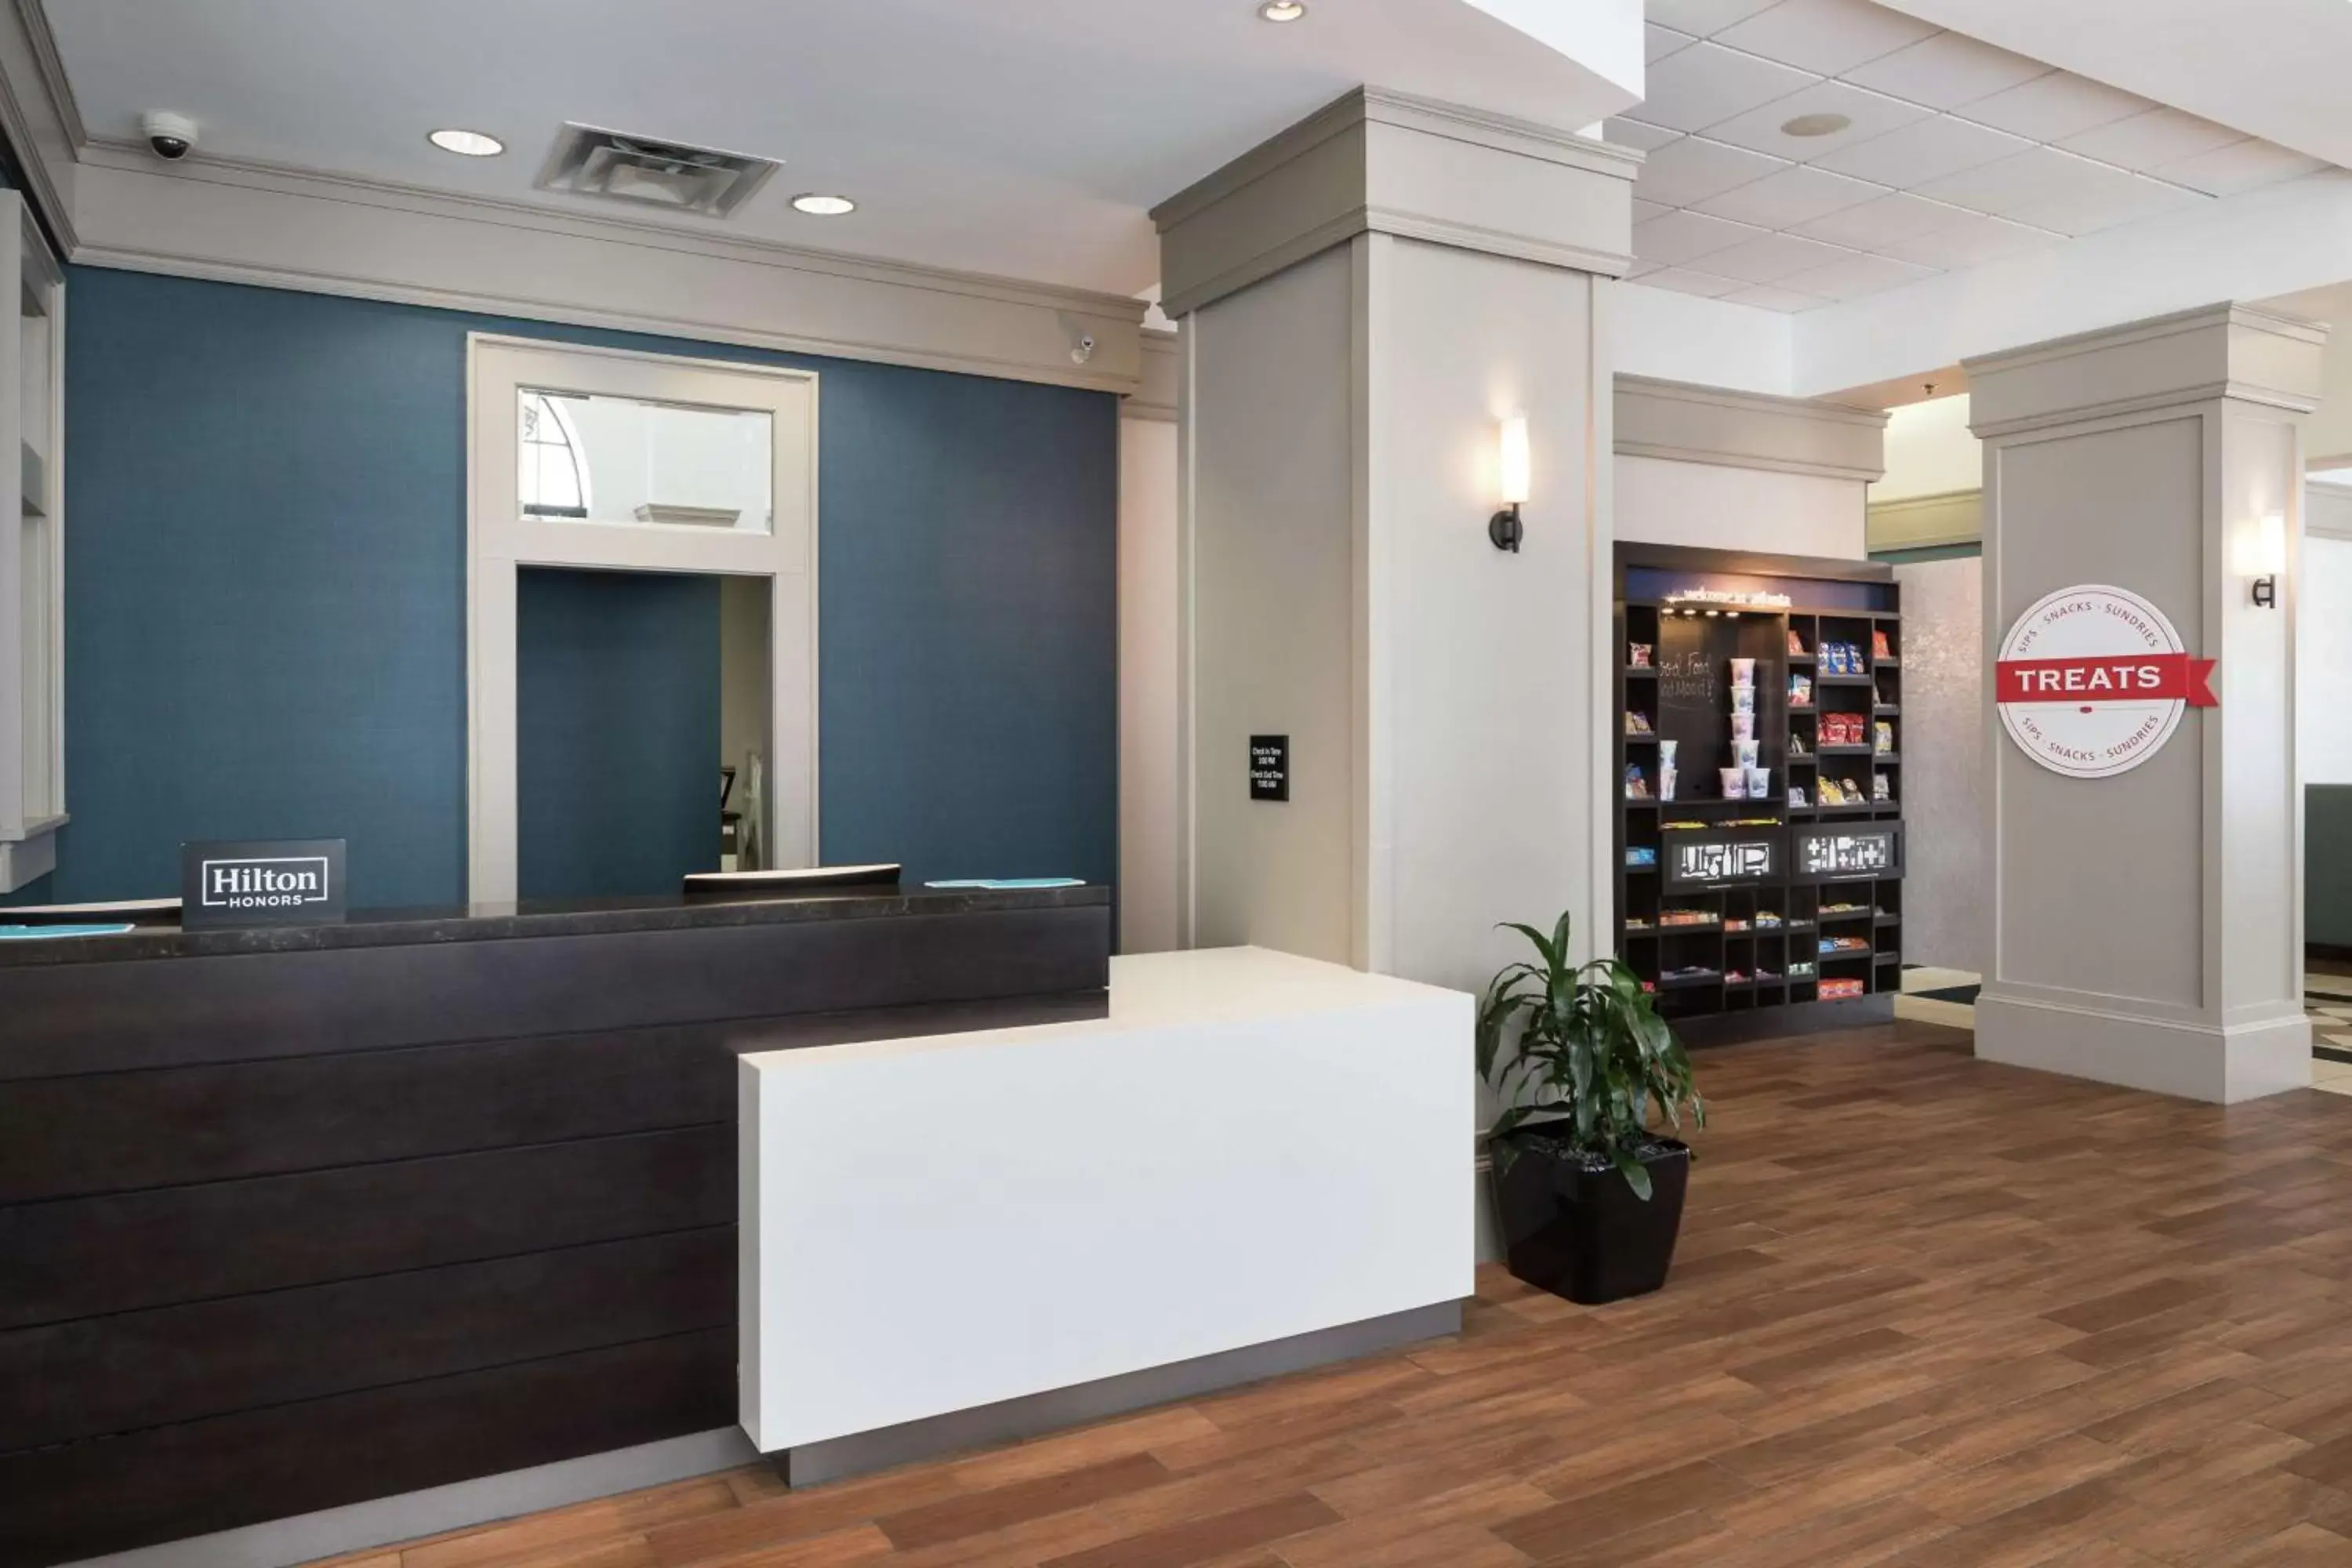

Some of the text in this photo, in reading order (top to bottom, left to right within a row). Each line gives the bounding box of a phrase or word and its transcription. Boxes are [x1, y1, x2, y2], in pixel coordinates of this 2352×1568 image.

[2018, 601, 2158, 653] SIPS SNACKS SUNDRIES
[2014, 665, 2161, 692] TREATS
[2021, 714, 2159, 761] SIPS SNACKS SUNDRIES
[213, 867, 318, 893] Hilton
[229, 895, 303, 908] HONORS
